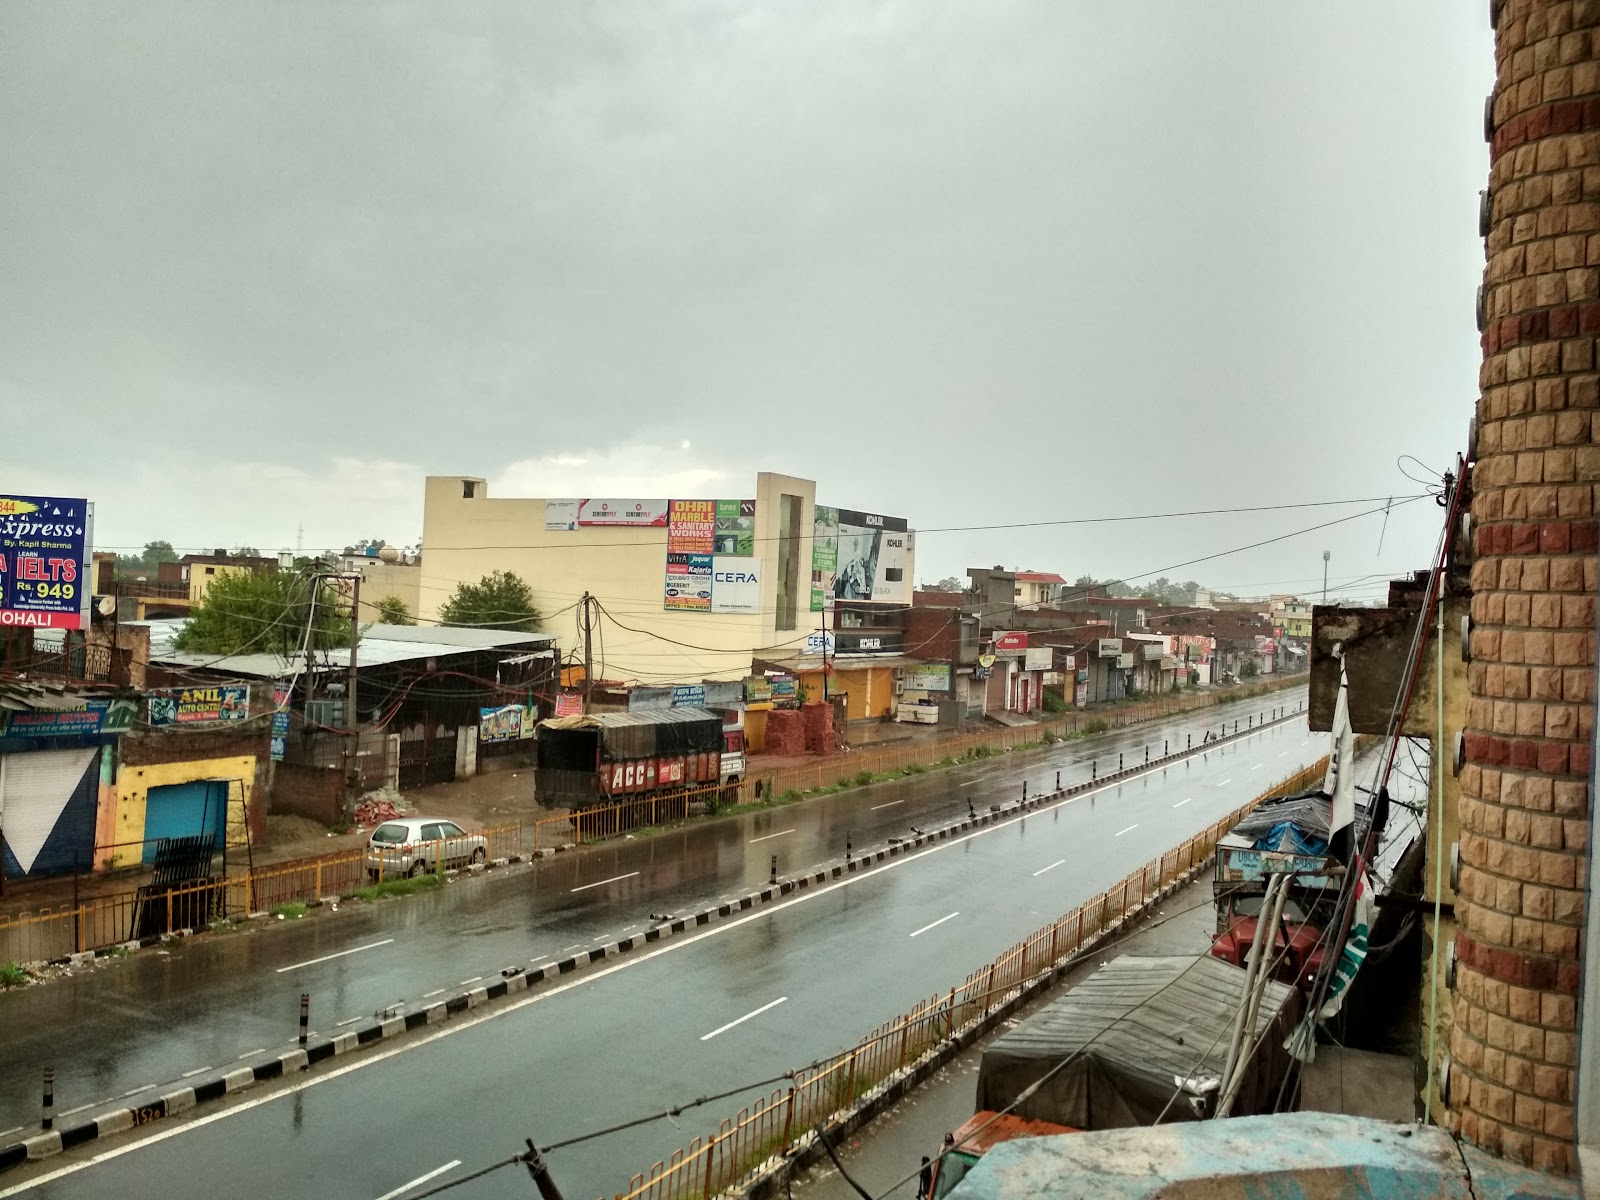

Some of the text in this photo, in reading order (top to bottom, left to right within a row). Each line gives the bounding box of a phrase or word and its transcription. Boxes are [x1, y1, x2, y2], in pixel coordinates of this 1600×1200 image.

[675, 501, 712, 512] OHRI
[671, 512, 715, 523] MARBLE
[866, 515, 884, 526] KOHLER
[669, 522, 715, 531] & SANITARY
[19, 541, 39, 549] Kapil
[887, 539, 902, 548] KOHLER
[16, 557, 76, 582] IELTS
[688, 565, 712, 574] Kajaria
[715, 573, 758, 583] CERA
[17, 582, 75, 600] Rs. 949
[859, 638, 881, 650] KOHLER
[179, 688, 223, 704] ANIL
[178, 704, 196, 714] AUTO
[57, 711, 101, 725] SHUTTER
[612, 765, 645, 789] ACC
